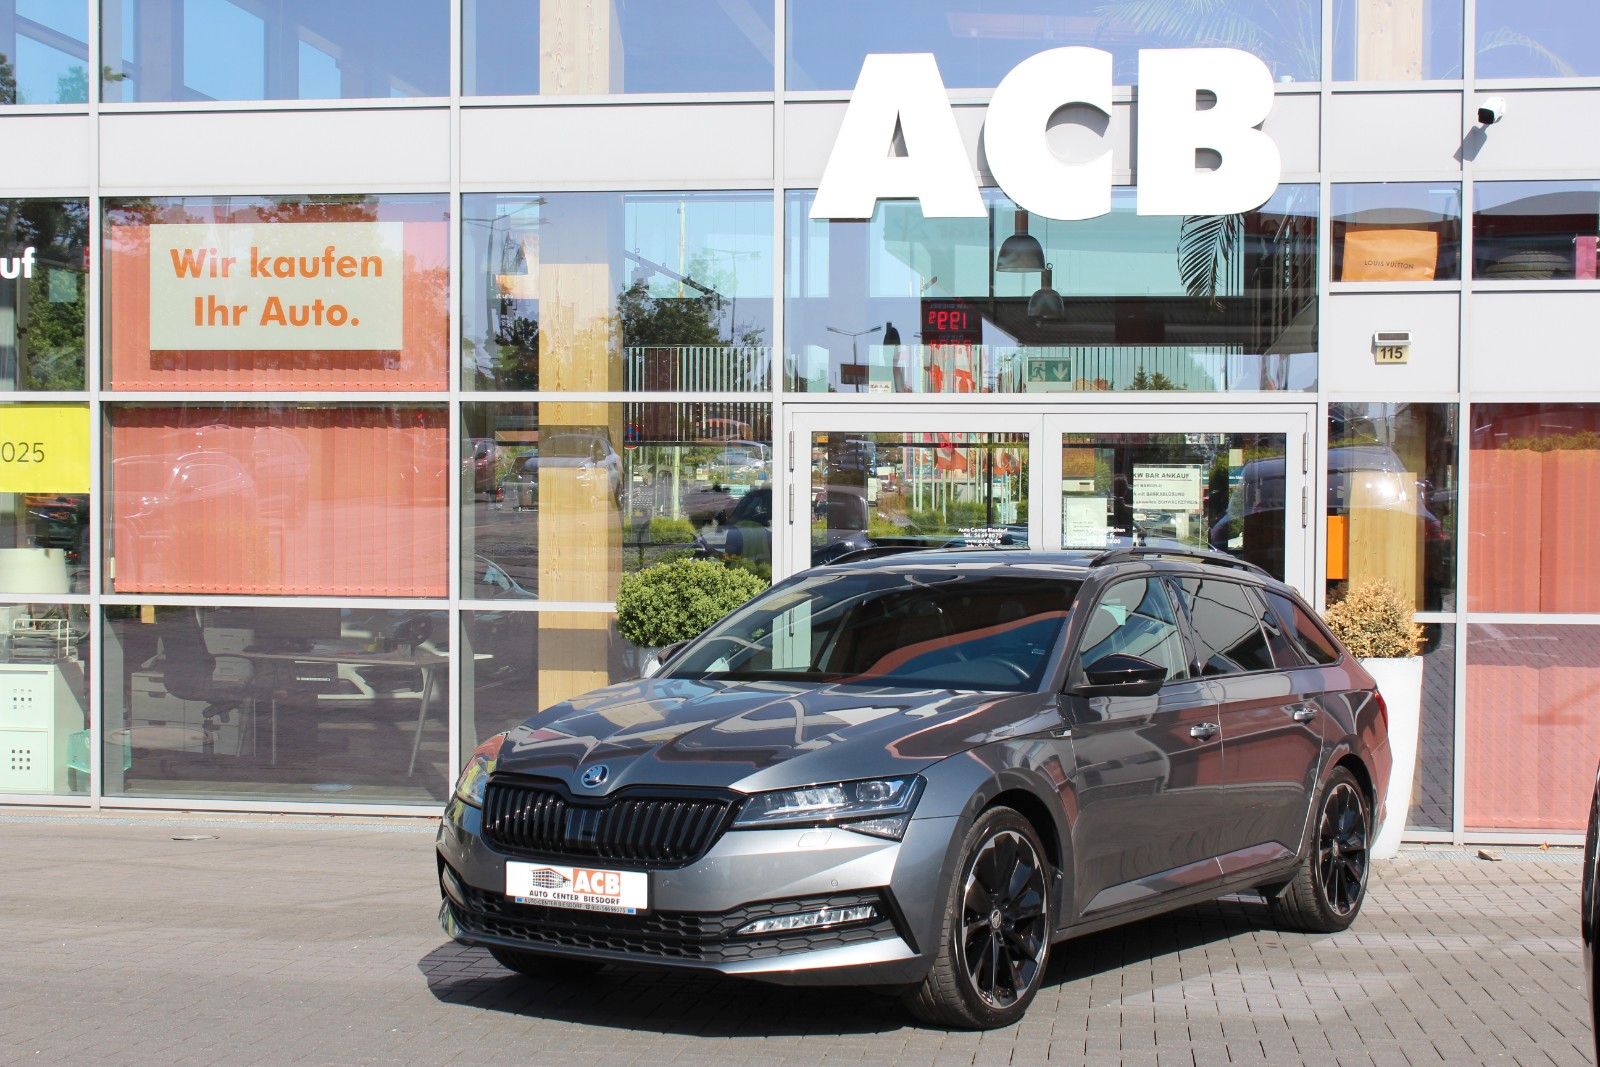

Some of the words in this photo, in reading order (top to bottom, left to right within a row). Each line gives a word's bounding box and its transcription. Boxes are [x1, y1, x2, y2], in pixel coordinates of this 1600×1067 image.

[809, 46, 1281, 221] ACB
[170, 247, 237, 278] Wir
[250, 245, 384, 279] kaufen
[1364, 259, 1384, 267] LOUIS
[1386, 260, 1415, 270] VUITTON
[194, 296, 249, 327] Ihr
[260, 296, 360, 327] Auto.
[1380, 346, 1403, 359] 115
[1, 441, 45, 463] 025
[574, 870, 620, 896] ACB
[529, 890, 548, 899] AUTO
[552, 892, 579, 901] CENTER
[584, 895, 620, 905] BIESDORF
